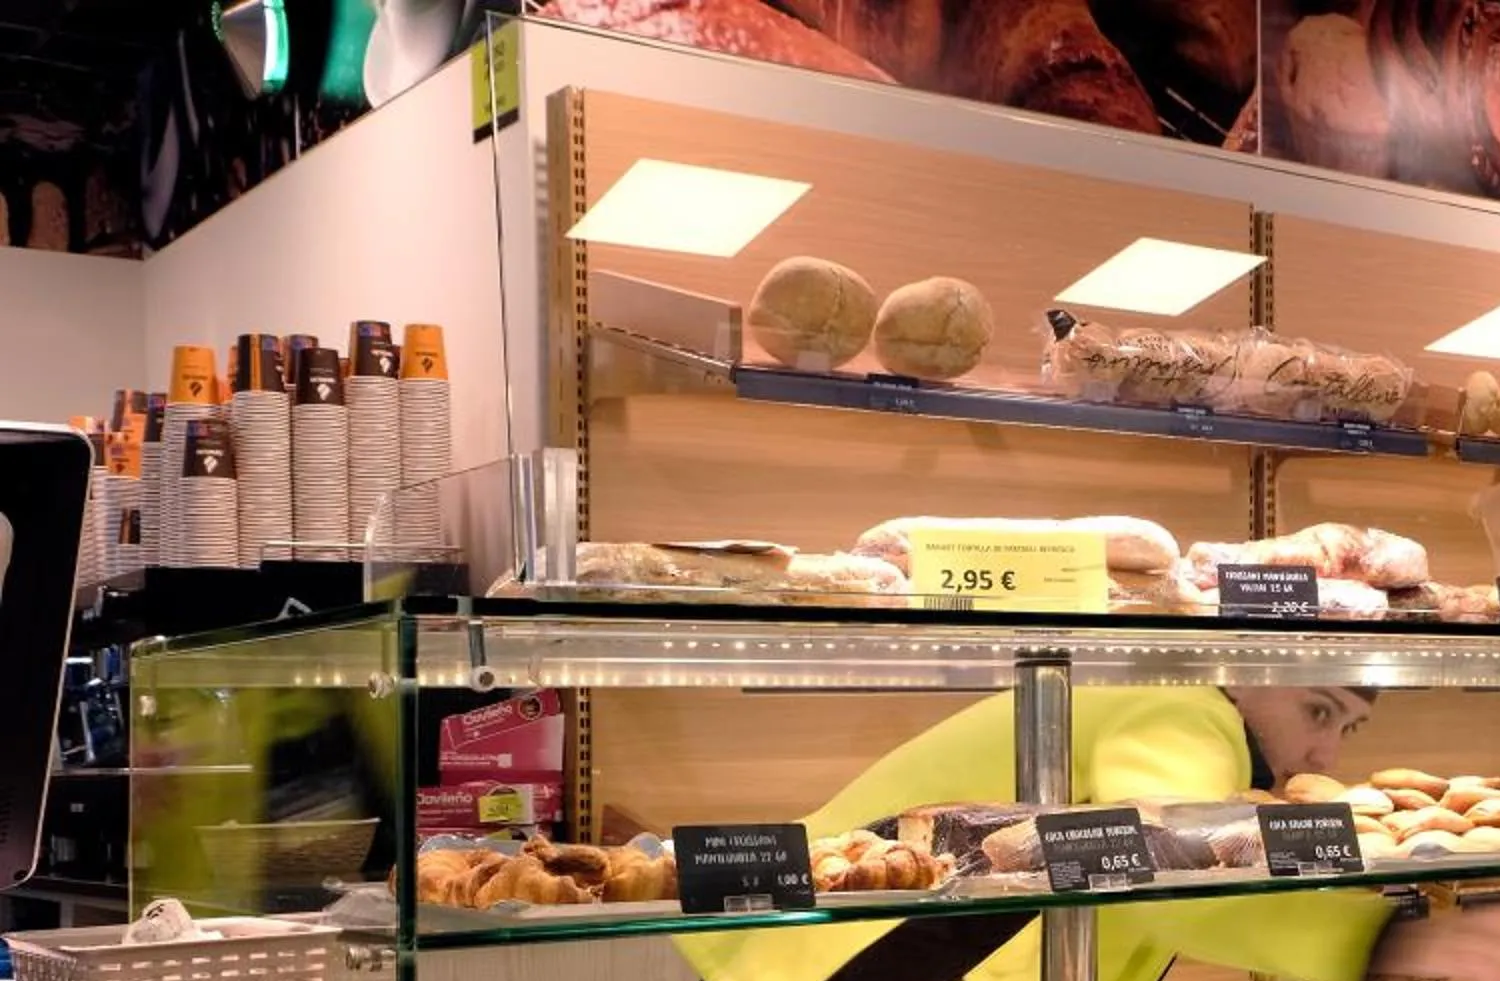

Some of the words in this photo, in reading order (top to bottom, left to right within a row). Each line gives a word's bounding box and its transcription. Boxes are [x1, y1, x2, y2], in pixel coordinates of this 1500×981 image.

[941, 569, 993, 592] 2,95
[1001, 571, 1016, 590] €
[1101, 855, 1129, 871] 0,65
[1131, 853, 1141, 867] €
